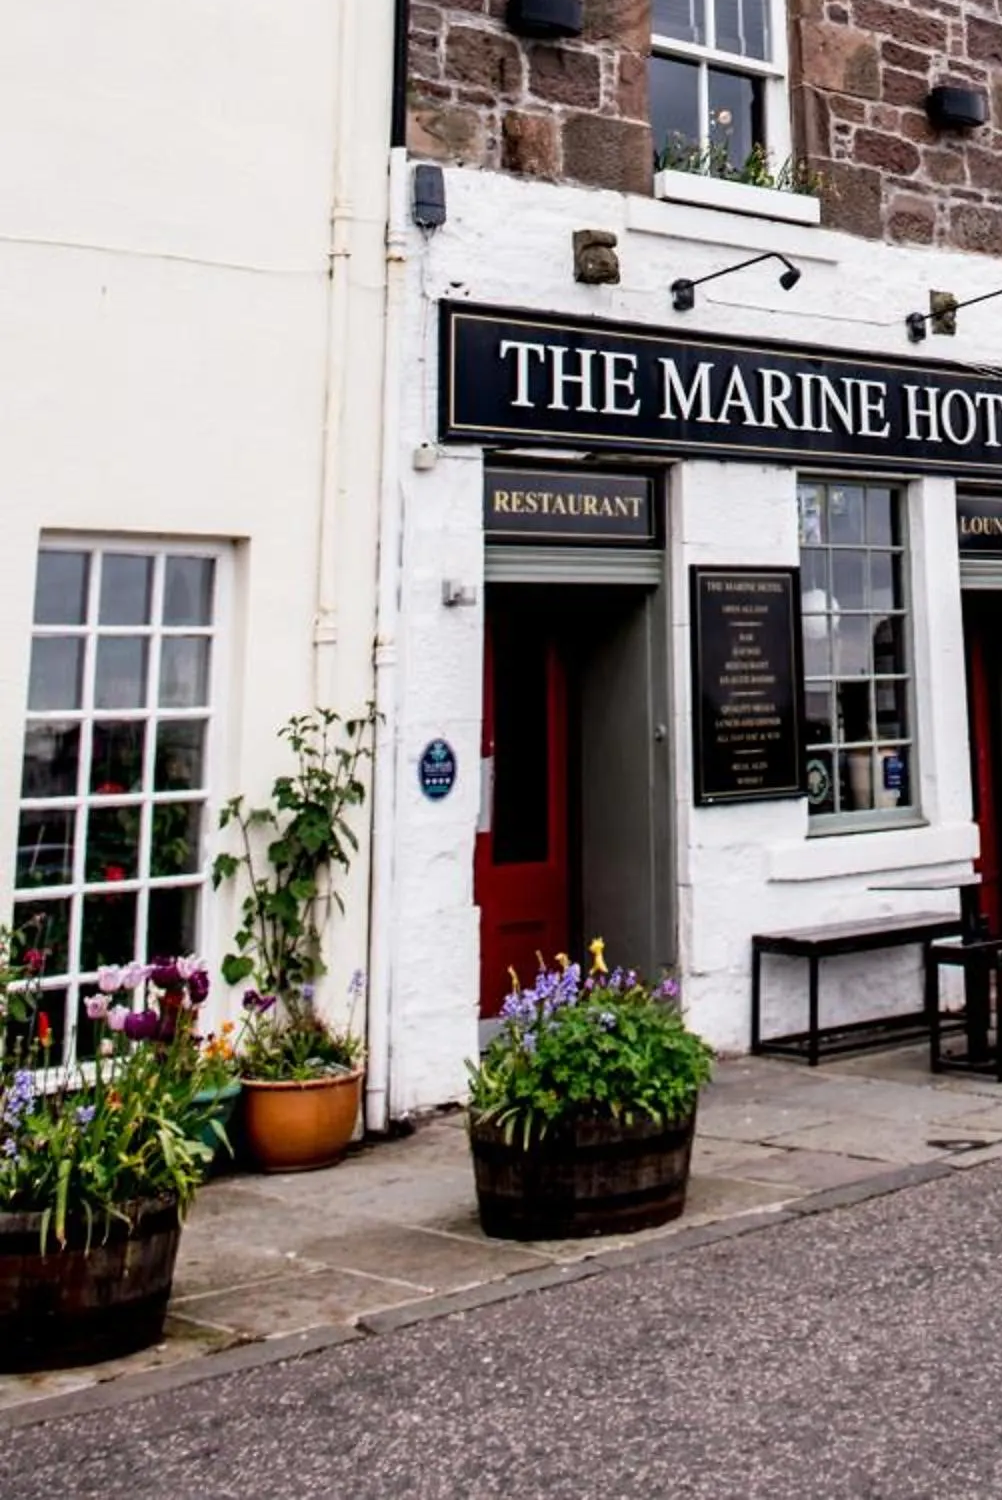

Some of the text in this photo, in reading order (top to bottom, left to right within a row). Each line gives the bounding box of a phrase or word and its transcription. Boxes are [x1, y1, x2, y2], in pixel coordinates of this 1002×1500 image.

[500, 340, 641, 417] THE
[657, 356, 892, 438] MARINE
[493, 490, 643, 518] RESTAURANT
[706, 581, 784, 593] THE MARINE HOTEL
